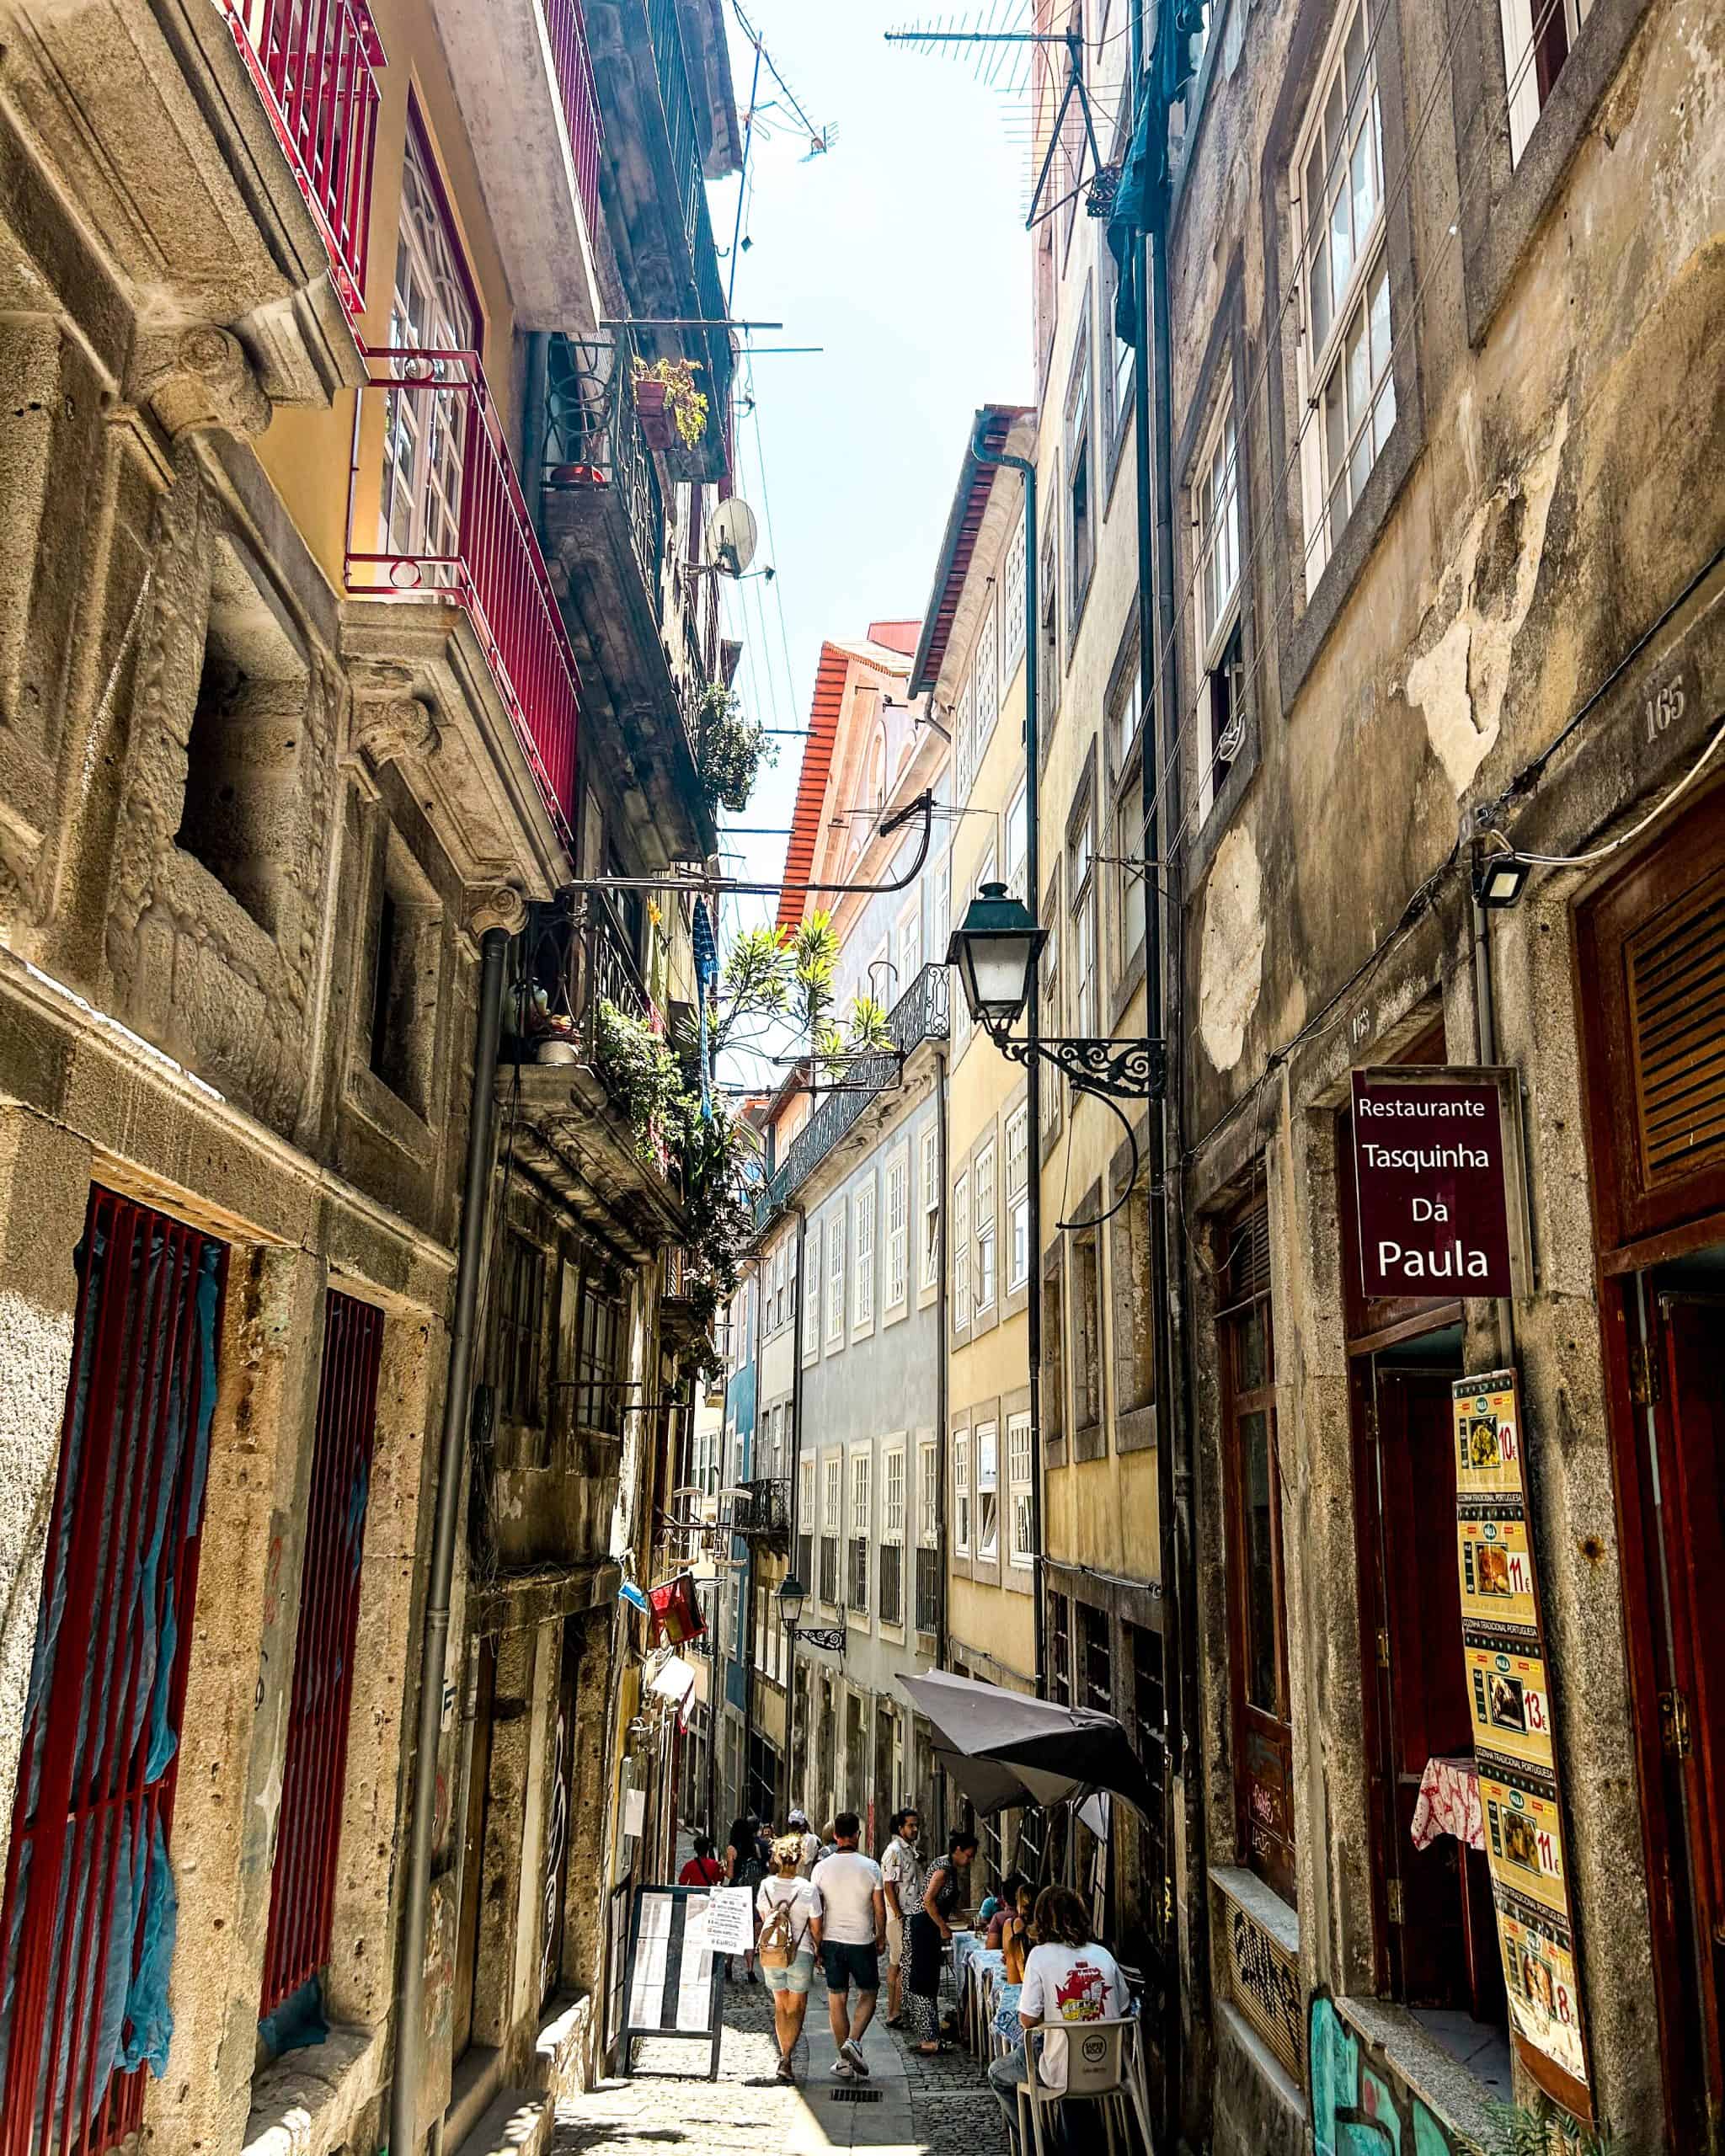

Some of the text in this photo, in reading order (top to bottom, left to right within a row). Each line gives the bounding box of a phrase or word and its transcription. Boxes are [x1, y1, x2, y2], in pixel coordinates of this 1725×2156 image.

[1645, 675, 1684, 744] 165
[1359, 1098, 1485, 1118] Restaurante
[1362, 1143, 1489, 1173] Tasquinha
[1412, 1198, 1448, 1222] Da
[1378, 1240, 1488, 1277] Paula
